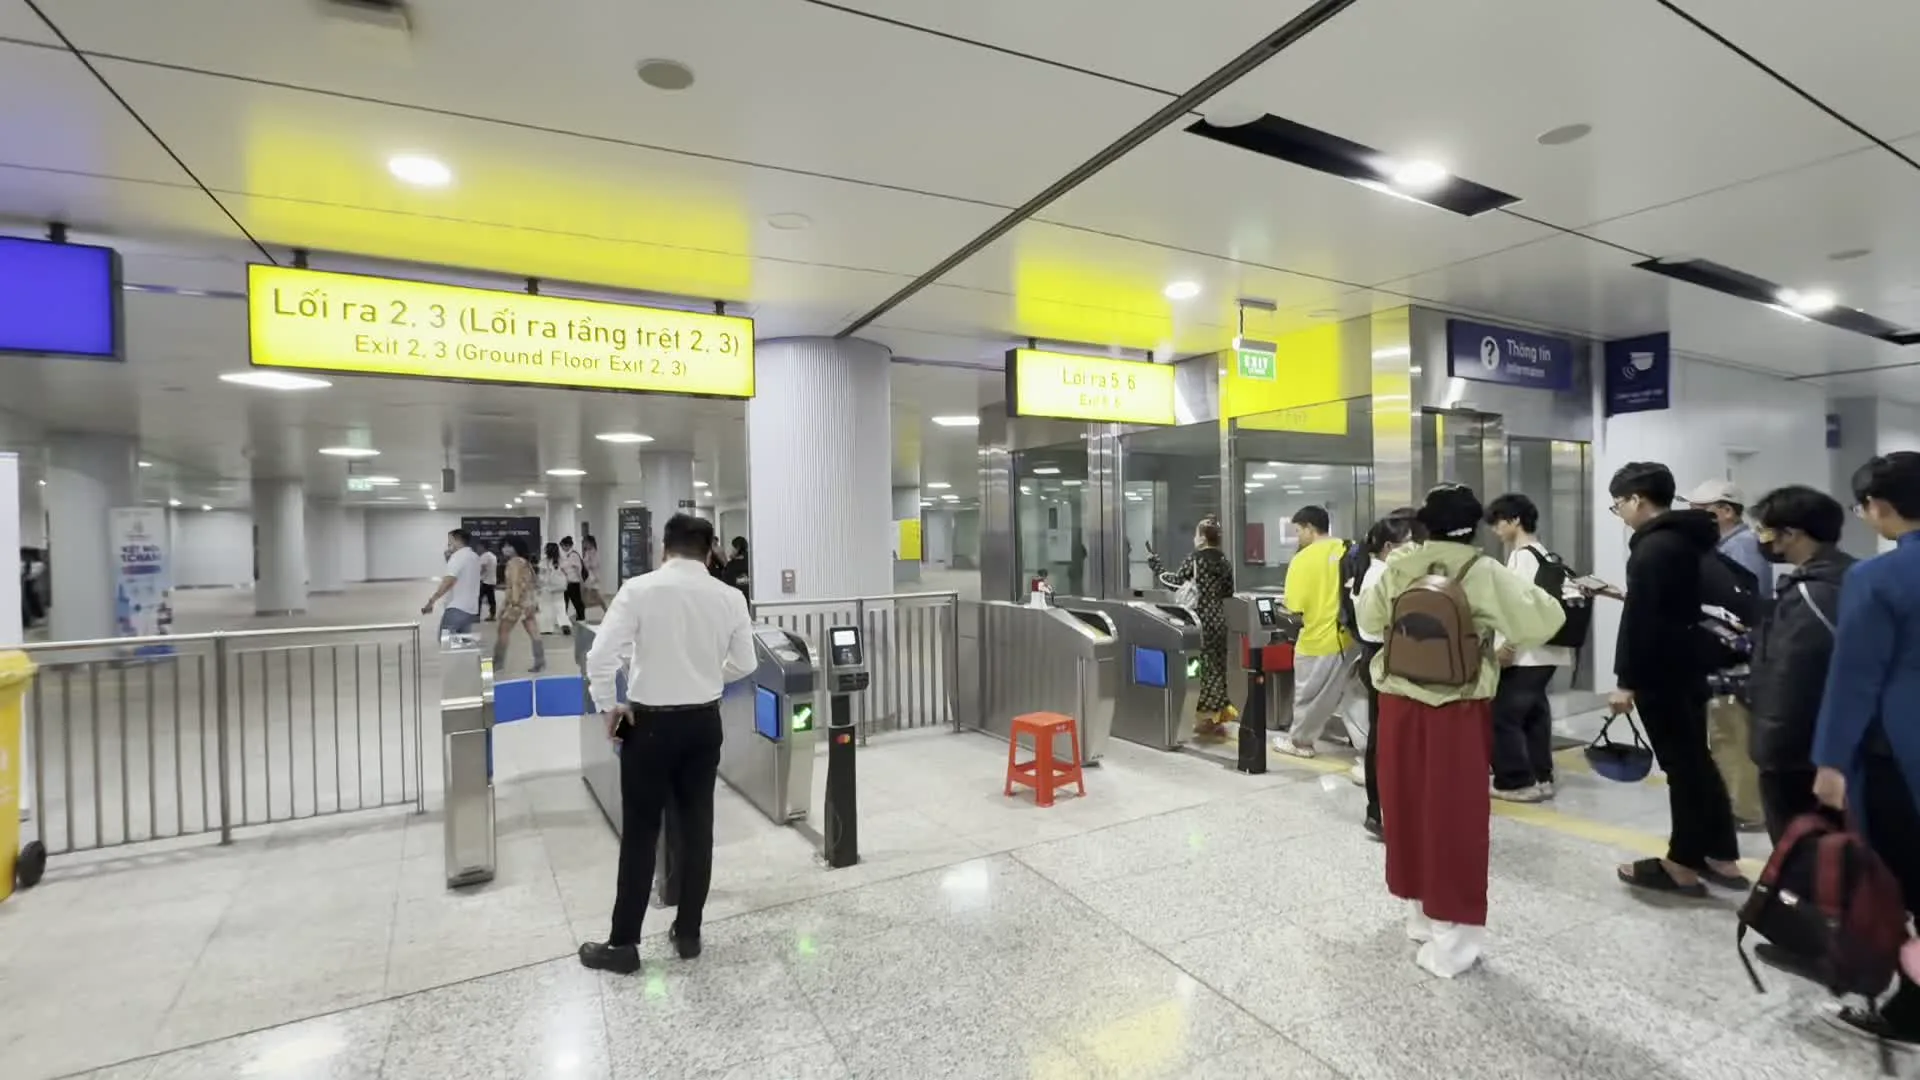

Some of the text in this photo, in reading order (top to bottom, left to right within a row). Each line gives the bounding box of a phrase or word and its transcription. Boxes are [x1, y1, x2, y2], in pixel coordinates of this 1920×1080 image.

[274, 288, 328, 318] Lối
[343, 302, 377, 323] ra
[429, 304, 446, 329] 3
[460, 307, 516, 335] (Lối
[528, 320, 556, 338] ra
[568, 316, 626, 350] tầng
[637, 324, 680, 354] trệt
[719, 332, 739, 356] 3)
[355, 334, 398, 355] Exit
[435, 341, 447, 359] 3
[456, 343, 543, 366] (Ground
[551, 350, 601, 369] Floor
[610, 355, 643, 373] Exit
[672, 360, 687, 377] 3)
